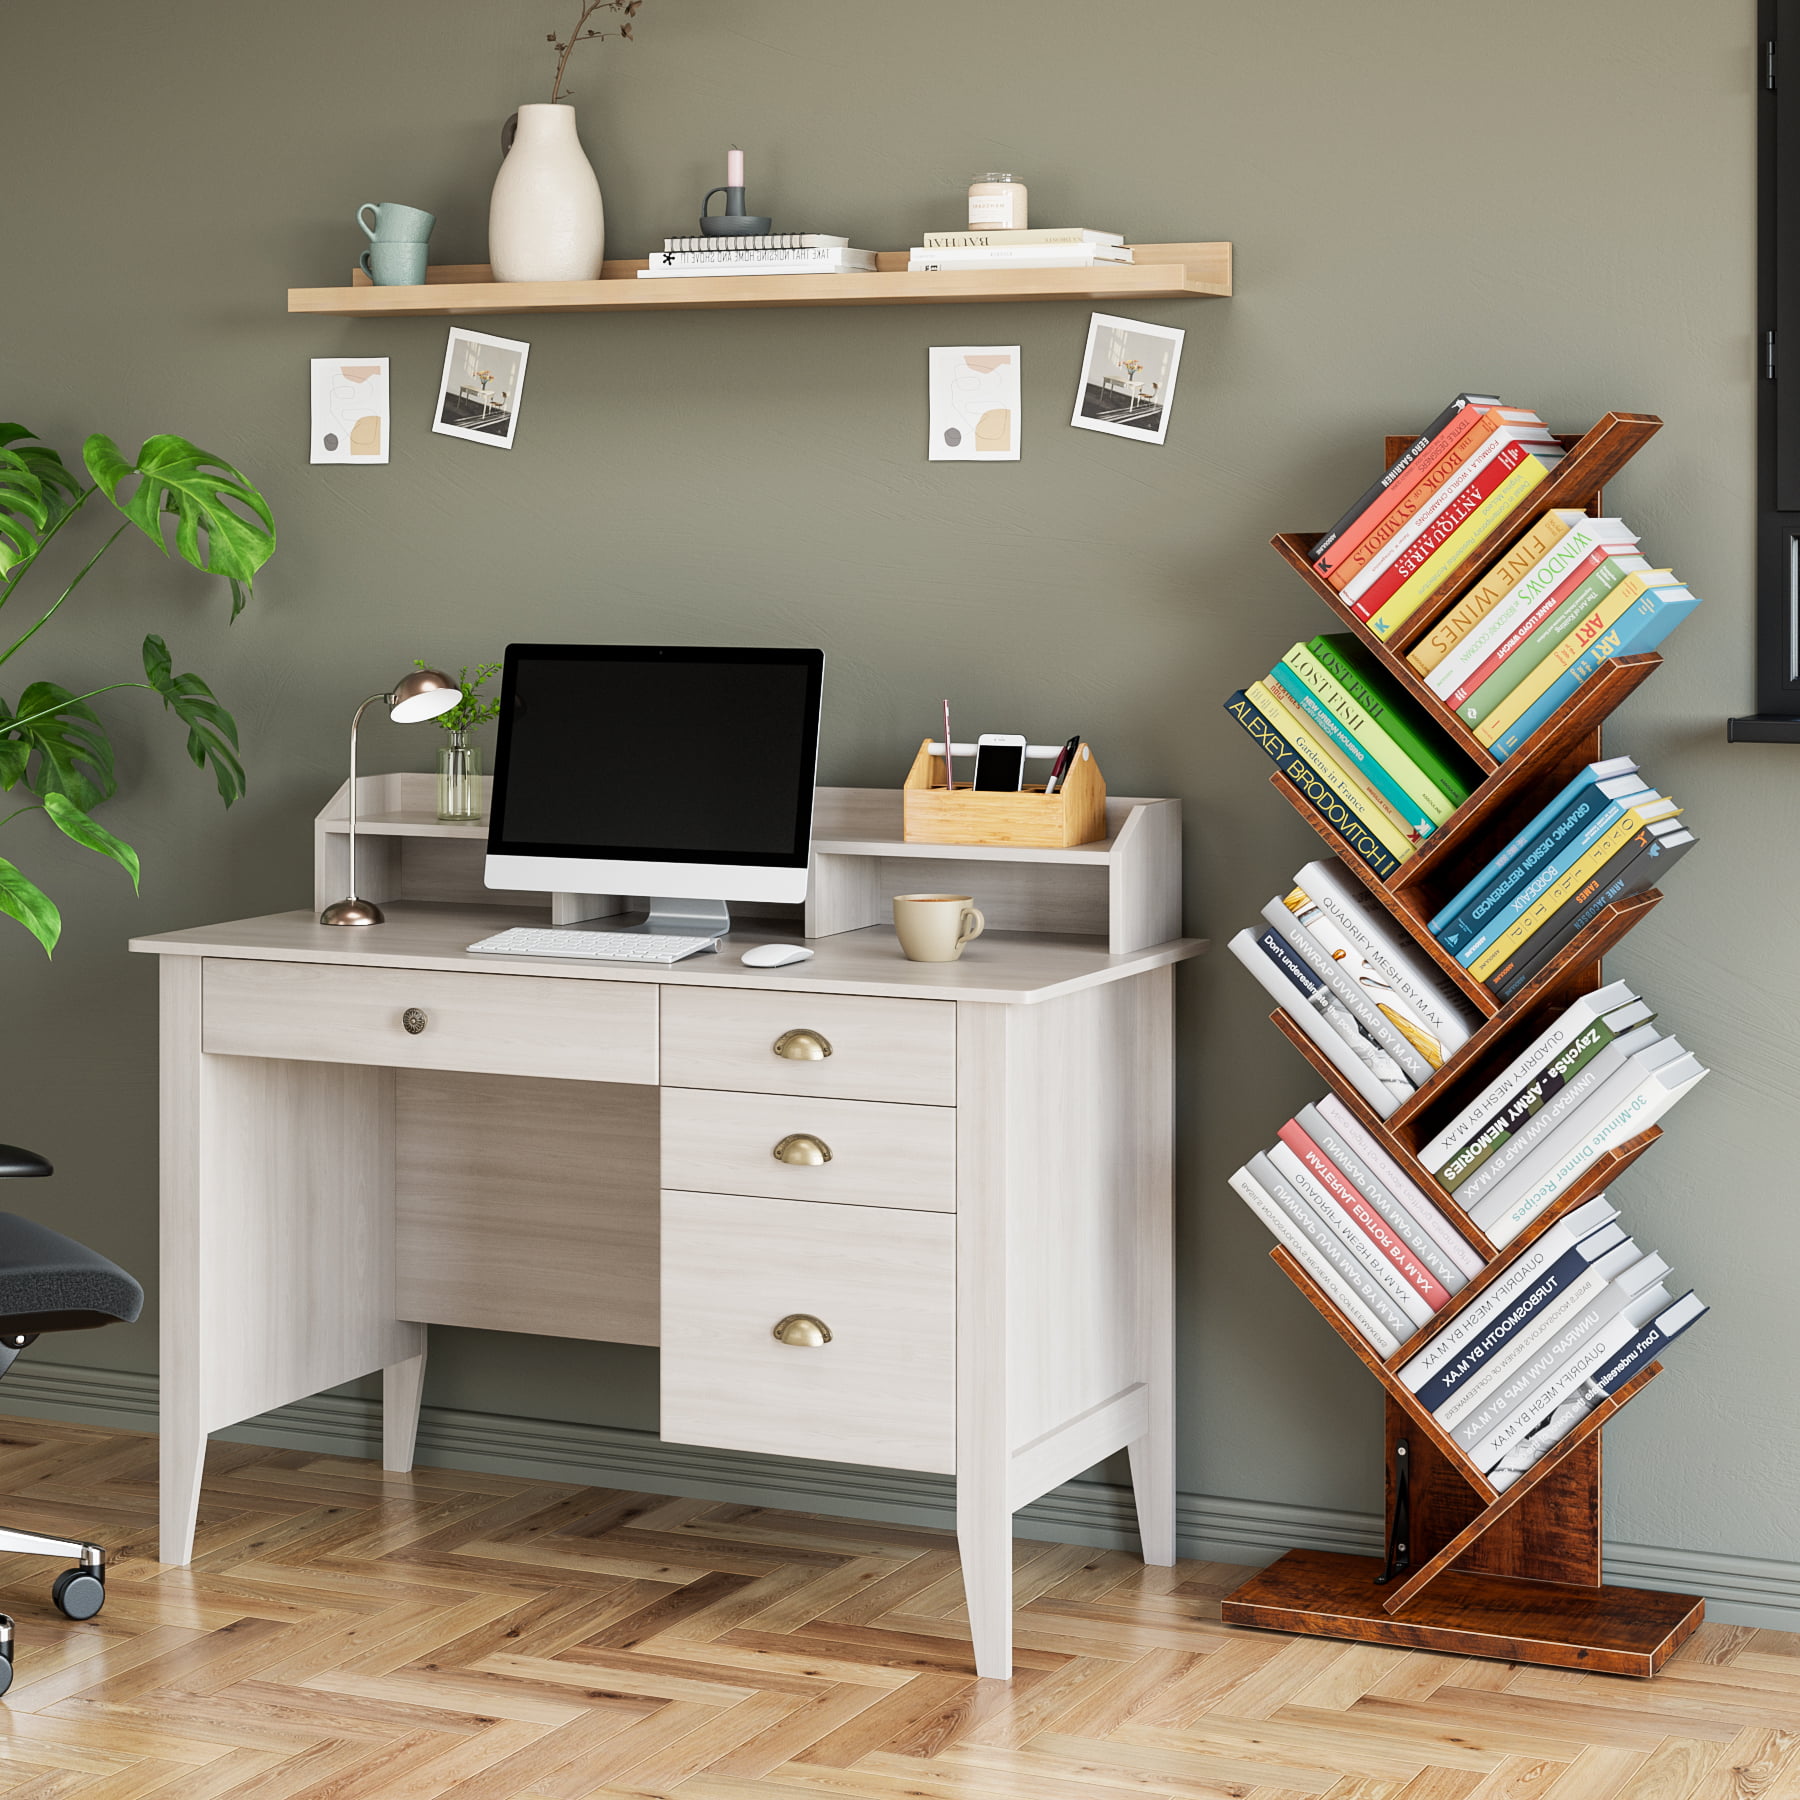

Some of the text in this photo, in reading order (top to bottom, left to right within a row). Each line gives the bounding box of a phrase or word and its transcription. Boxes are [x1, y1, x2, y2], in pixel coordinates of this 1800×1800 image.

[1380, 436, 1430, 487] EERO SAARINEN
[1416, 418, 1469, 473] TEXTILE DESIGNERS
[1457, 436, 1473, 452] THE
[1470, 439, 1499, 469] FORMULA
[1421, 451, 1463, 493] BOOK
[1445, 470, 1469, 494] WORLD
[1351, 498, 1418, 567] SYMBOLS
[1394, 486, 1485, 578] ANTIQUAIRES
[1414, 491, 1448, 527] CHAMPIONS
[1495, 535, 1546, 586] FINE
[1515, 528, 1592, 605] WINDOWS
[1428, 583, 1499, 654] WINES
[1516, 614, 1538, 637] LLOYD
[1535, 596, 1557, 618] FRANK
[1571, 612, 1607, 648] ART
[1494, 632, 1520, 659] WRIGHT
[1587, 628, 1624, 665] ART
[1289, 651, 1365, 731] LOST FISH
[1312, 642, 1385, 719] LOST FISH
[1302, 695, 1365, 762] NEW URBAN HOUSING
[1228, 696, 1387, 867] ALEXEY BRODOVITCH
[1293, 735, 1367, 814] Gardens in France
[1550, 801, 1591, 842] GRAPHIC
[1521, 836, 1555, 870] DESIGN
[1469, 866, 1525, 920] REFERENCED
[1509, 864, 1558, 912] BORDEAUX
[1572, 878, 1625, 930] ARNE JACOBSEN
[1574, 879, 1599, 904] EAMES
[1262, 934, 1285, 957] Don't
[1279, 954, 1331, 1008] underestimate
[1321, 896, 1444, 1029] QUADRIFY MESH BY M.AX
[1287, 928, 1421, 1074] UNWRAP UVW MAP BY M.AX
[1544, 1025, 1601, 1080] ZaychSa
[1440, 1029, 1565, 1149] QUADRIFY MESH BY M.AX
[1504, 1081, 1545, 1121] ARMY
[1441, 1116, 1509, 1181] MEMORIES
[1463, 1071, 1595, 1198] UNWRAP UVW MAP BY M.AX
[1509, 1093, 1647, 1224] 30-Minute Dinner Recipes
